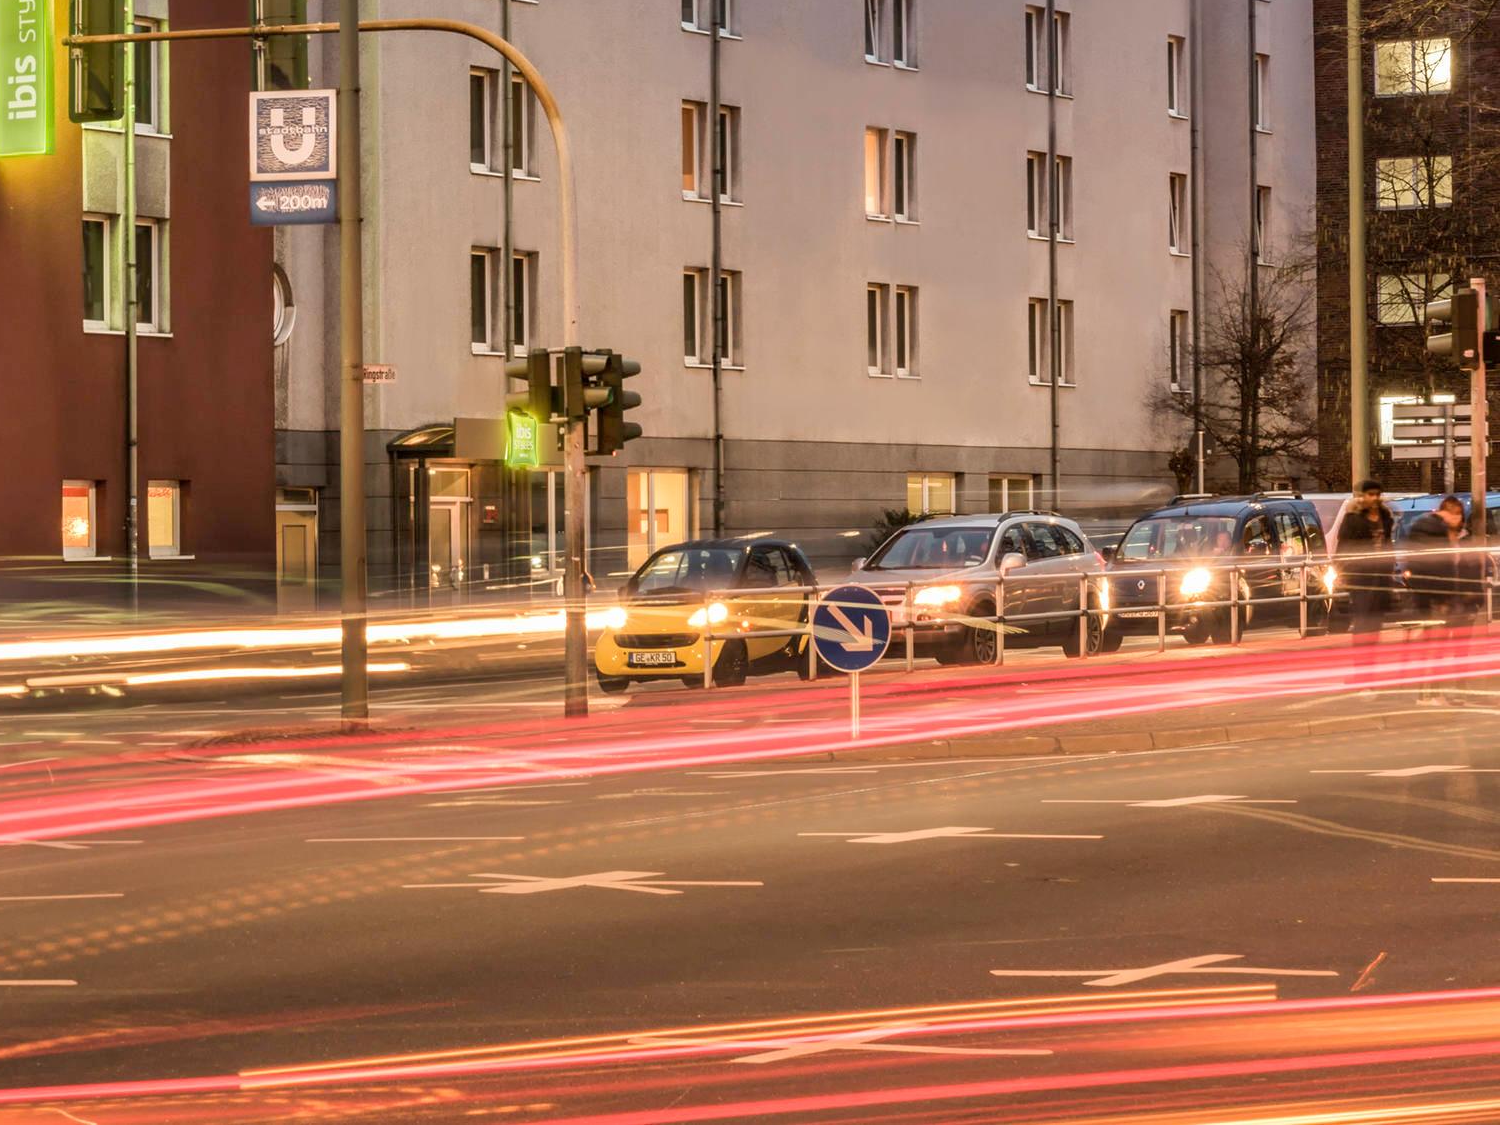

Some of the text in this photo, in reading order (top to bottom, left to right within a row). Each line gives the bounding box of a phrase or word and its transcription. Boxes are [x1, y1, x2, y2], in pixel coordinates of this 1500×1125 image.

[8, 54, 37, 120] ibis
[258, 124, 329, 136] stadtbahn
[279, 195, 329, 210] 200m
[635, 653, 646, 663] GE
